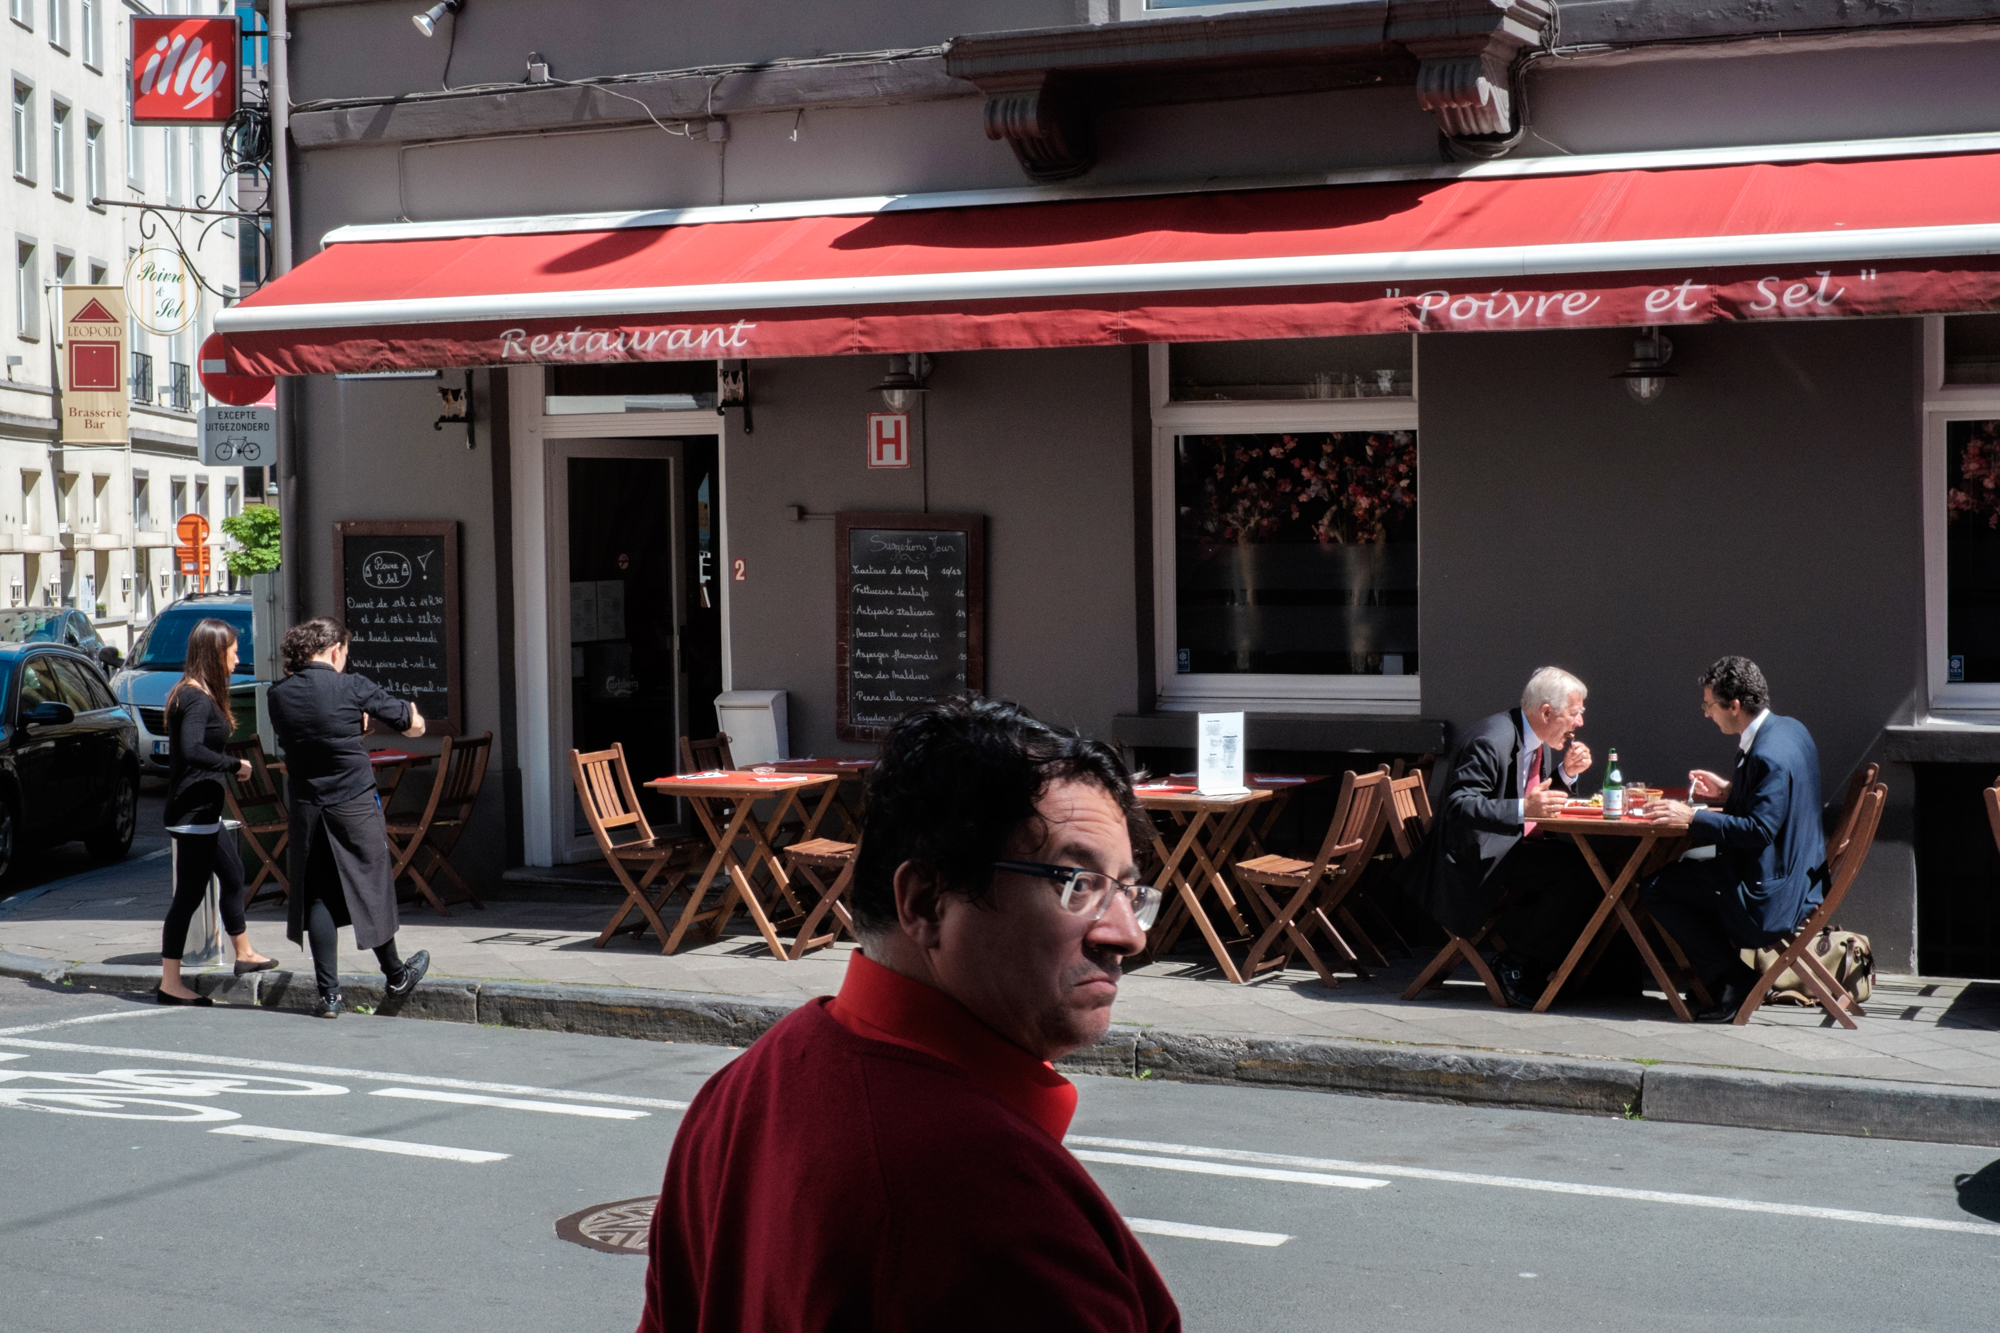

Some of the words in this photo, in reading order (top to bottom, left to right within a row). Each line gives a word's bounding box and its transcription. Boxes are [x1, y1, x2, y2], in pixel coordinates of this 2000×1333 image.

[140, 33, 227, 110] illy
[136, 261, 186, 284] Poivre
[155, 286, 165, 297] &
[1644, 277, 1708, 313] et
[155, 297, 185, 318] Sel
[67, 325, 122, 338] LEOPOLD
[500, 318, 756, 359] Restaurant
[68, 406, 122, 418] Brasserie
[218, 411, 257, 420] EXCEPTE
[84, 418, 106, 429] Bar
[206, 422, 270, 432] UITGEZONDERD
[876, 420, 902, 460] H
[929, 535, 956, 559] Jour
[735, 560, 745, 580] 2
[852, 564, 887, 574] Tartare
[890, 566, 902, 574] de
[377, 574, 384, 585] &
[896, 586, 930, 602] tartufo
[346, 597, 374, 608] Ouvert
[376, 598, 388, 608] de
[361, 614, 370, 624] et
[374, 613, 386, 624] de
[352, 631, 365, 642] du
[368, 631, 391, 642] lundi
[404, 631, 438, 643] vendredi
[880, 628, 898, 638] lune
[856, 649, 890, 665] Asperges
[892, 649, 938, 662] flamandes
[875, 670, 890, 680] des
[892, 668, 930, 680] Maldives
[606, 676, 638, 692] Carlsberg
[882, 690, 904, 702] alla
